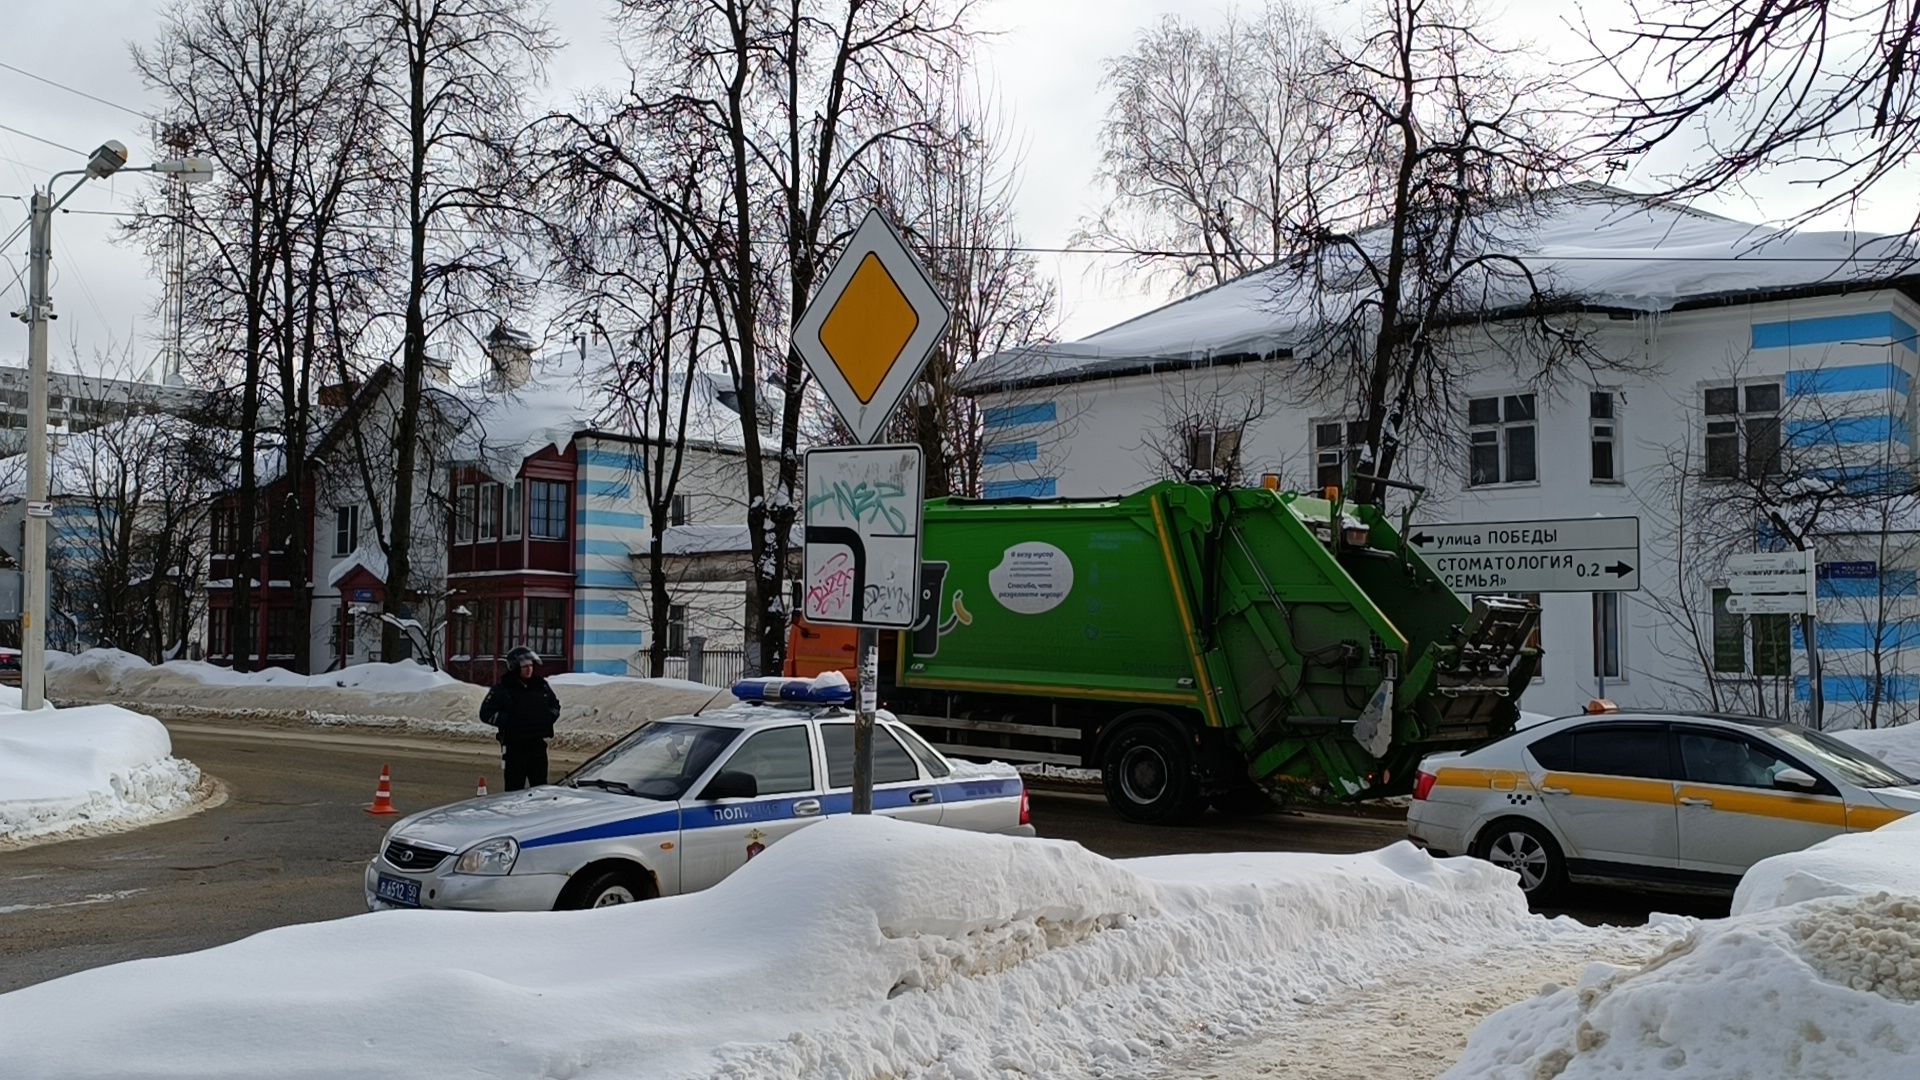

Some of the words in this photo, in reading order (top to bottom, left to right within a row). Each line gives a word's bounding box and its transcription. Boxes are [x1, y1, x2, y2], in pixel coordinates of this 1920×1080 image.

[1437, 534, 1481, 549] улица
[1488, 529, 1557, 545] ПОБЕДЫ
[1437, 554, 1573, 571] СТОМАТОЛОГИЯ
[1576, 562, 1600, 577] 0.2
[1444, 573, 1507, 588] СЕМЬЯ»
[714, 806, 777, 821] ПОЛИЦИ
